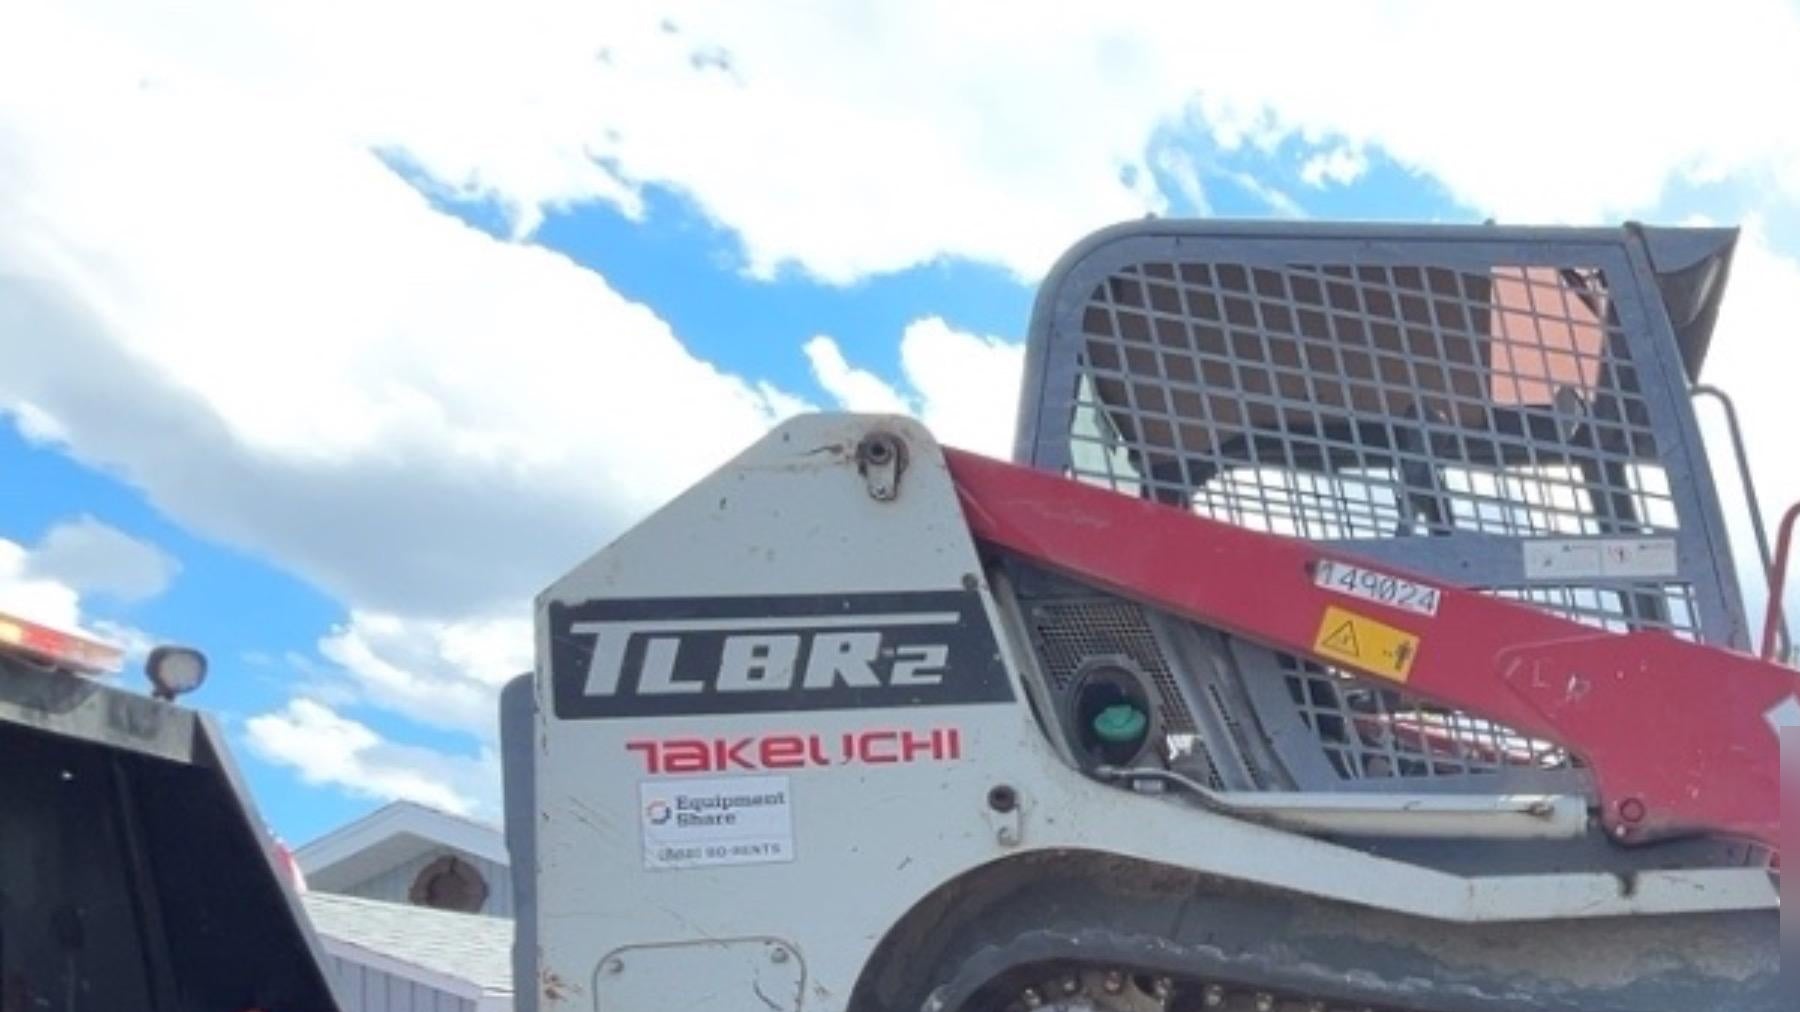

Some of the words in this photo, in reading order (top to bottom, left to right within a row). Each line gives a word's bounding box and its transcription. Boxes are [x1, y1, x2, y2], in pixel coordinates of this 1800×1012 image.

[1319, 561, 1437, 612] 149024
[676, 791, 786, 813] Equipment
[676, 811, 736, 828] Share
